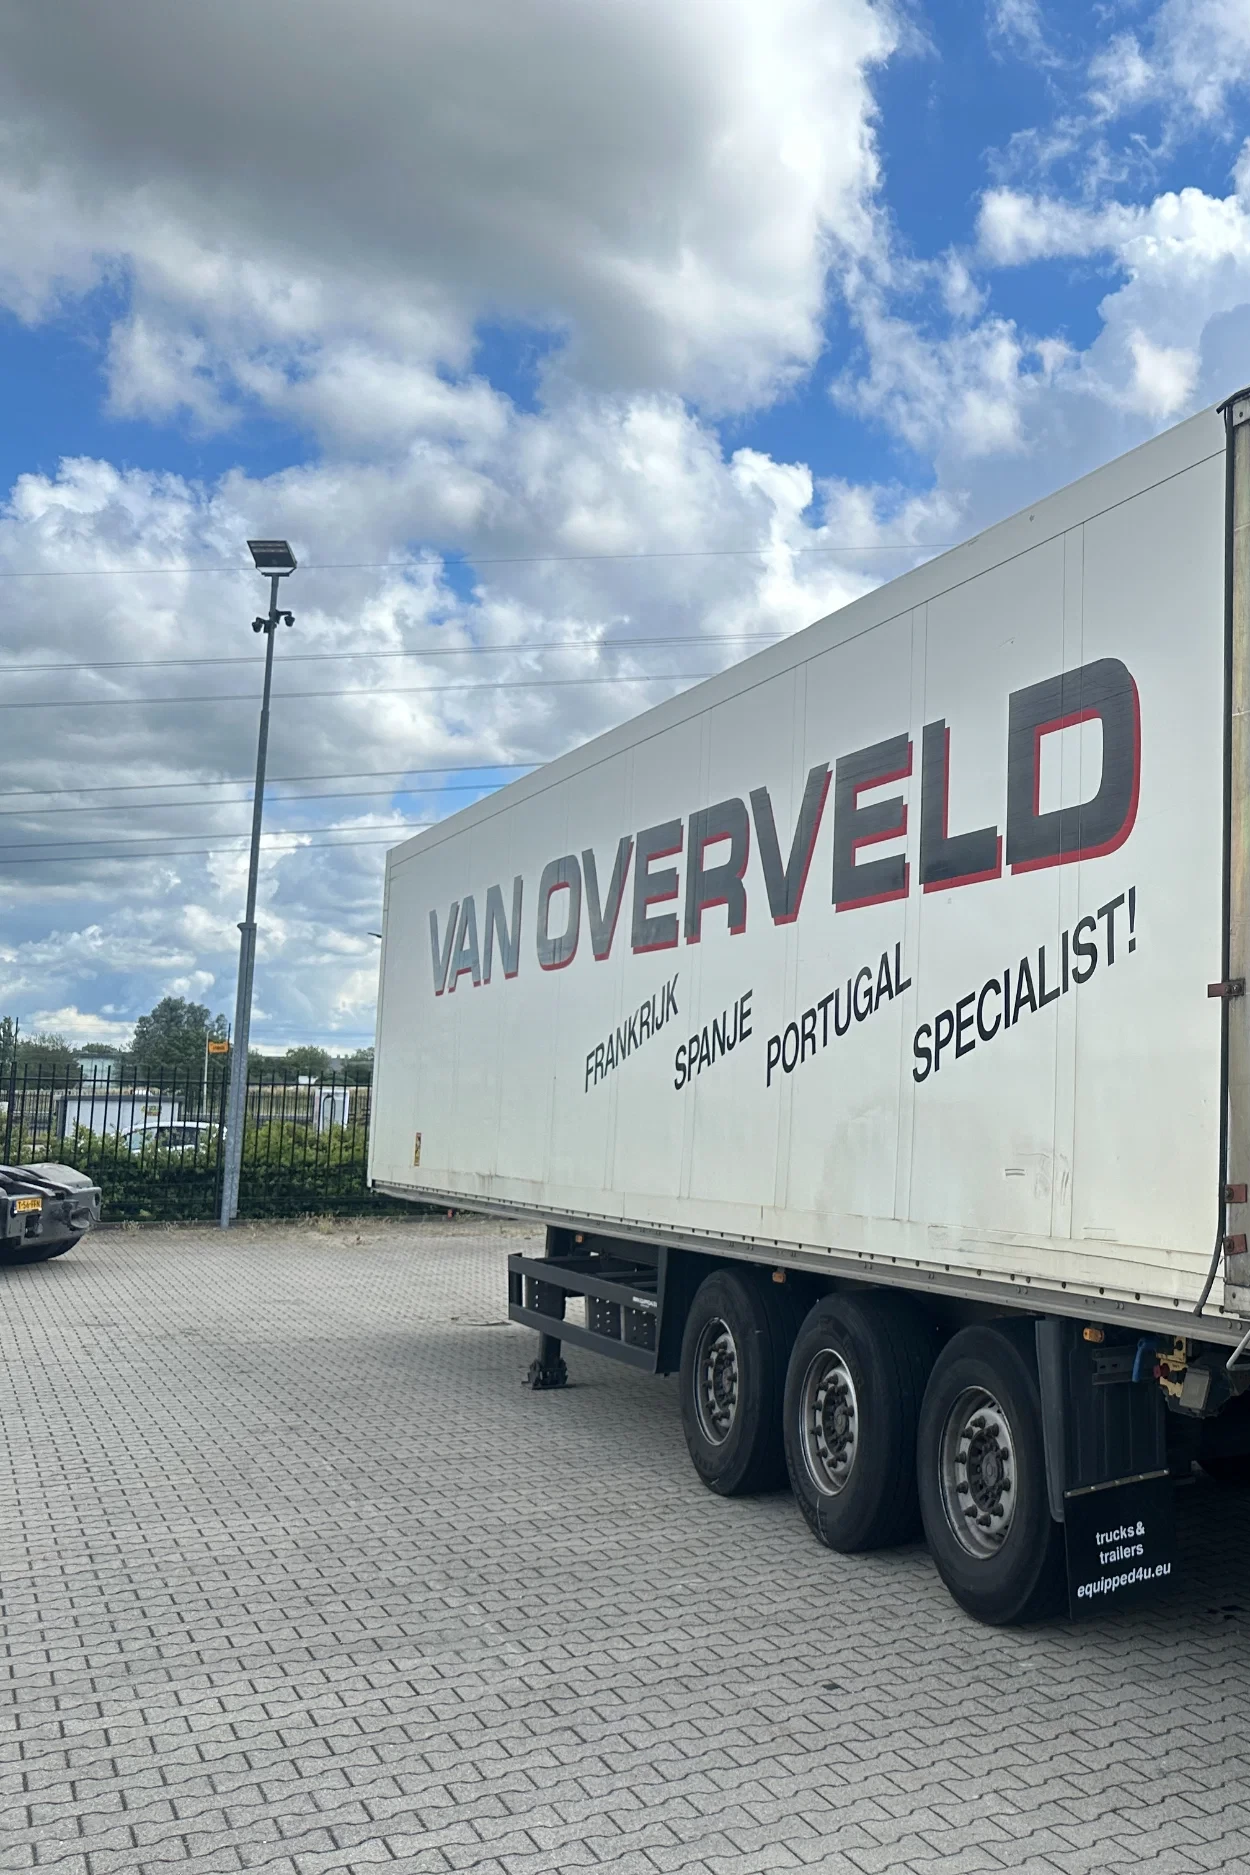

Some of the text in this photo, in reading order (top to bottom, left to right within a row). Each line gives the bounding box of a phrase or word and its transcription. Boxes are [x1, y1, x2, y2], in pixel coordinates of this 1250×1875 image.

[429, 657, 1141, 997] VAN OVERVELD
[585, 886, 1138, 1093] FRANKRIJK SPANJE PORTUGAL SPECIALIST!
[1077, 1562, 1171, 1598] equipped4u.eu
[1099, 1543, 1144, 1565] trailers
